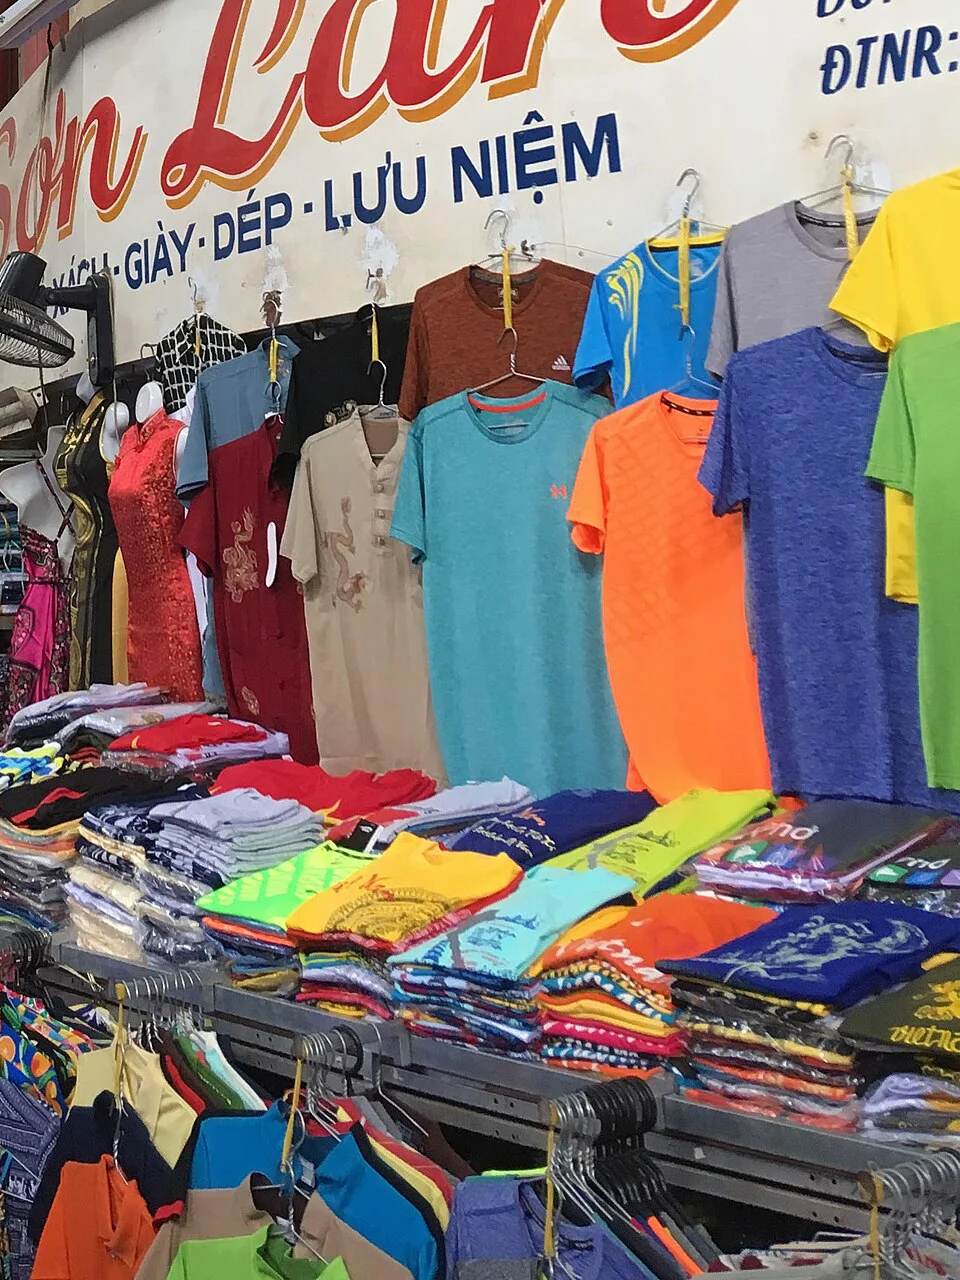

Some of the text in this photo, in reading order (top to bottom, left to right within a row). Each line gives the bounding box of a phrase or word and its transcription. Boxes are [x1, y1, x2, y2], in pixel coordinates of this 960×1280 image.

[820, 24, 959, 95] ĐTNR:
[124, 219, 197, 290] GIÀY
[213, 187, 293, 262] DÉP
[324, 150, 428, 232] LƯU
[450, 109, 623, 205] NIỆM
